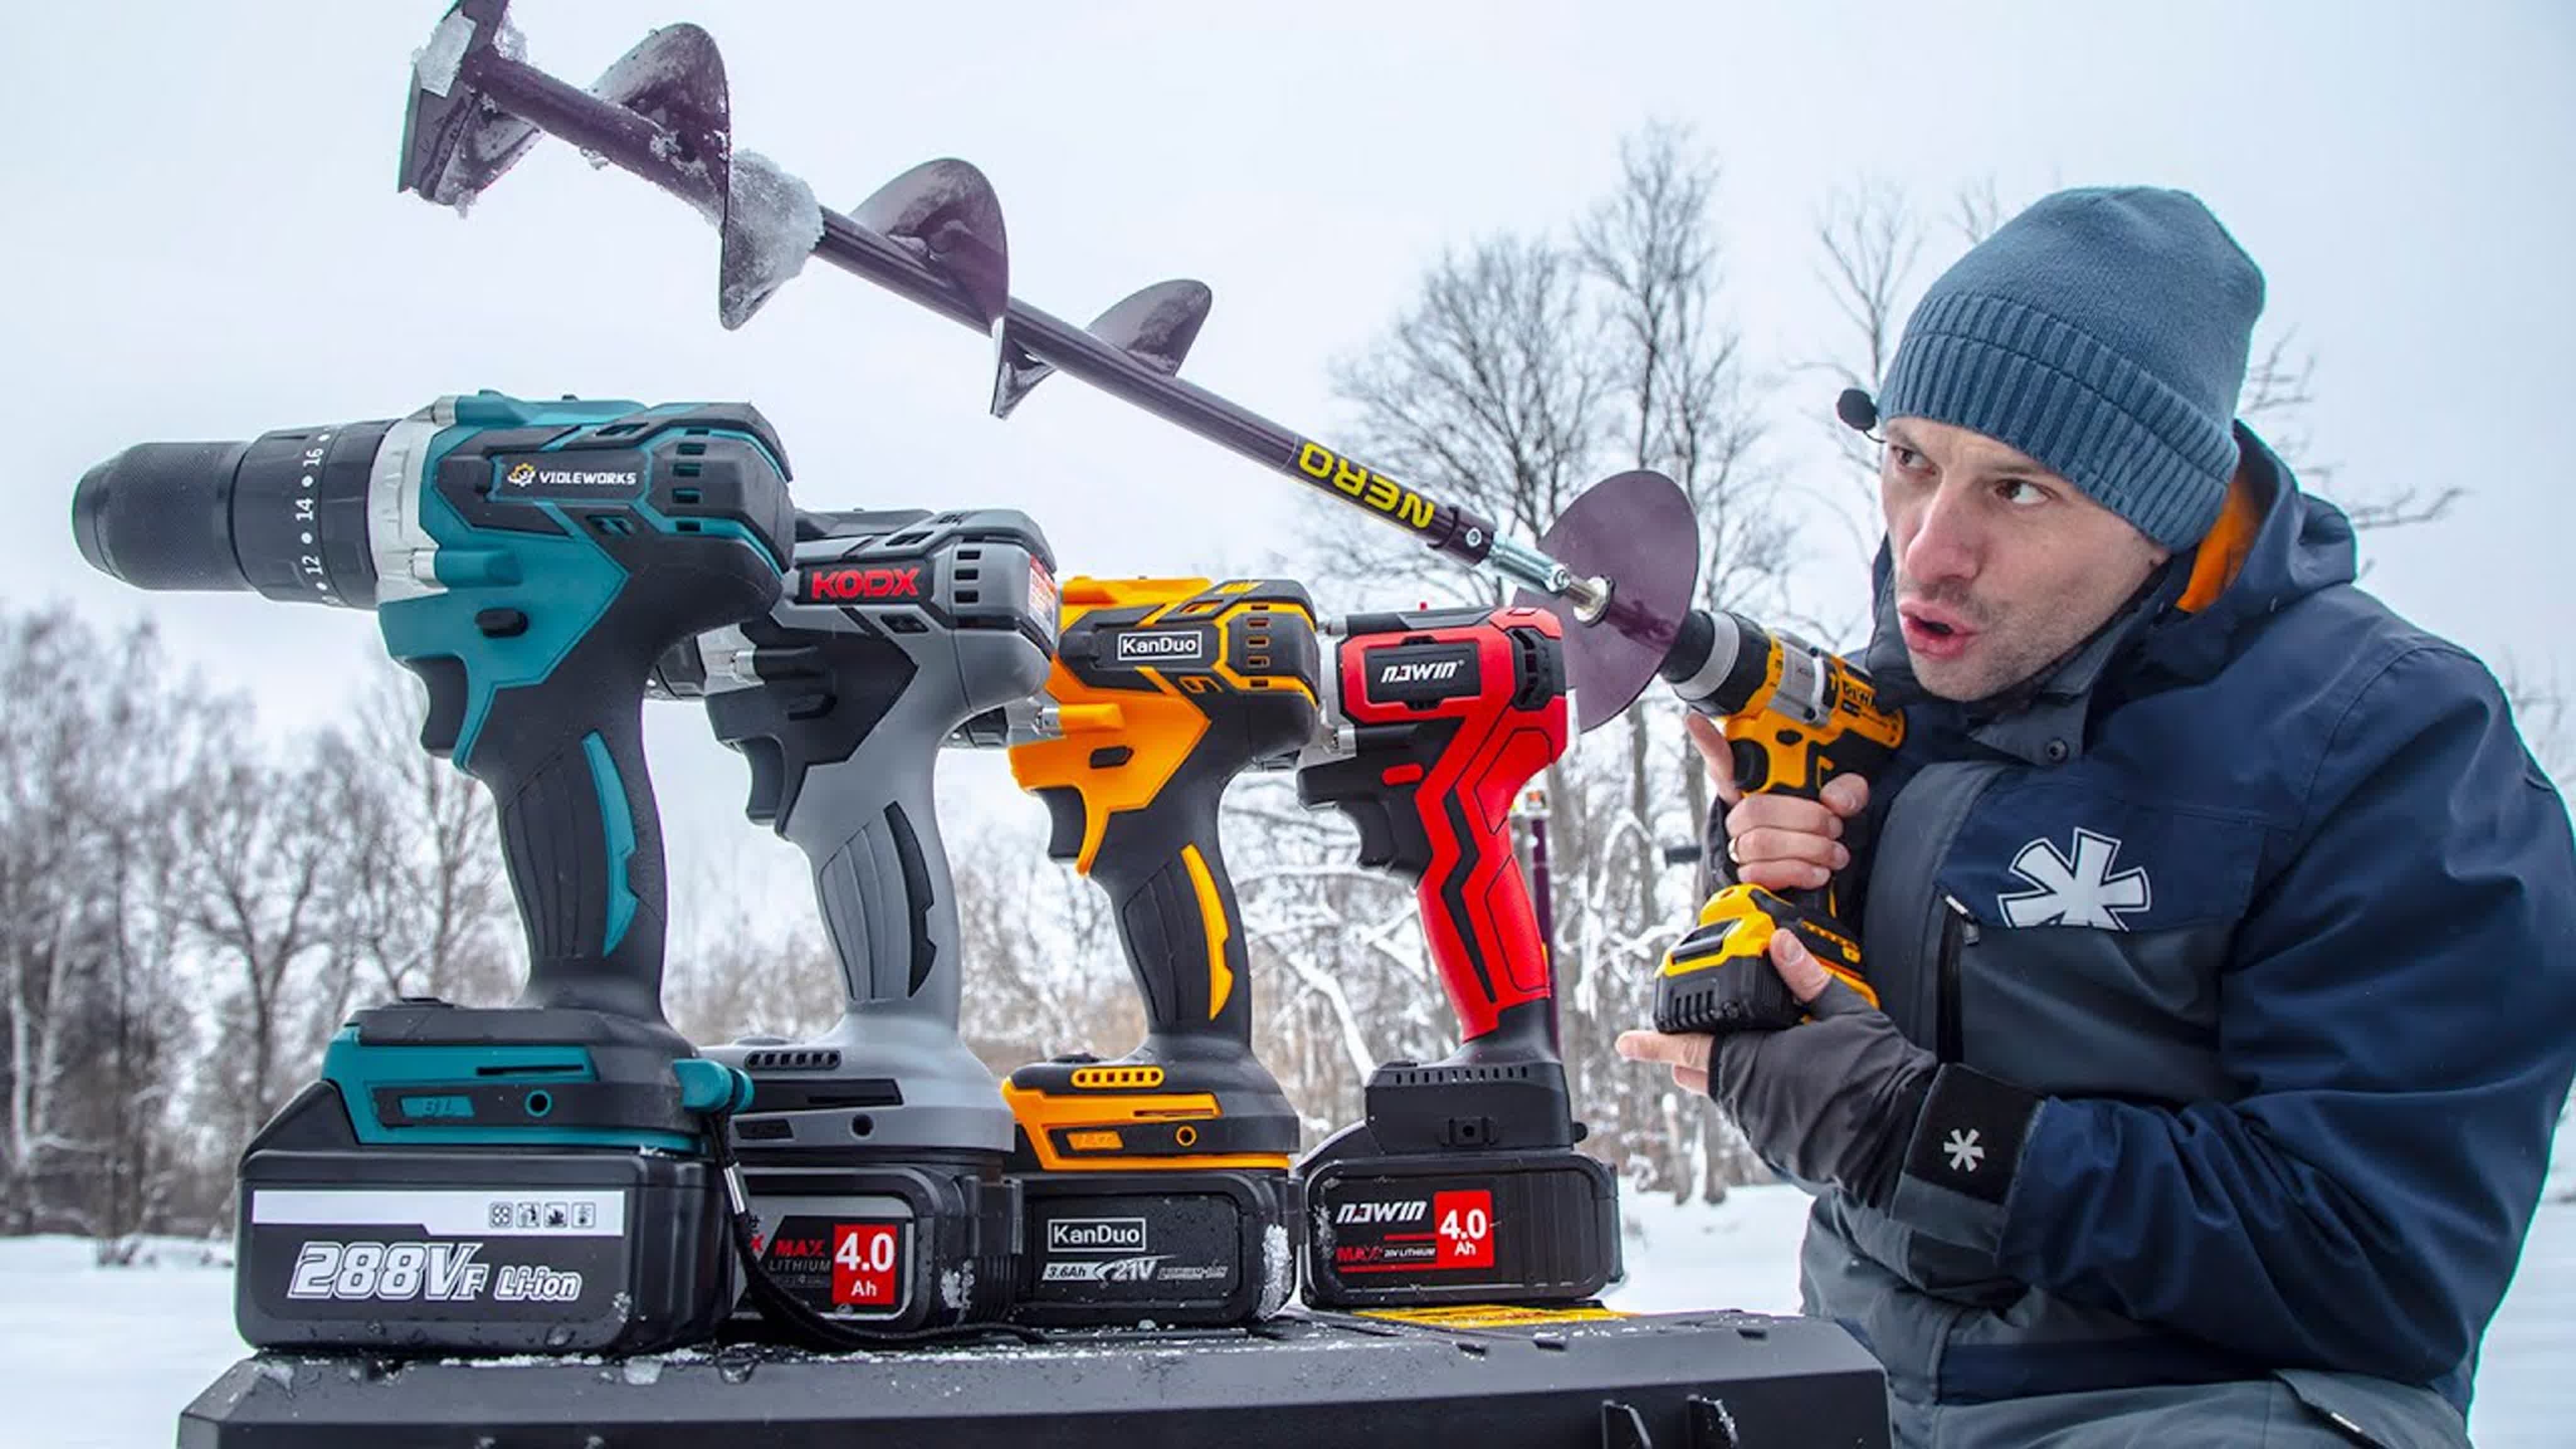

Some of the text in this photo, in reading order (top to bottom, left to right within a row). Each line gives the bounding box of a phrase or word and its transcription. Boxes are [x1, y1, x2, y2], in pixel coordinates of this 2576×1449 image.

[539, 472, 636, 485] VIOLEWORKS
[1298, 441, 1435, 529] NERO
[296, 448, 324, 575] 12 14 16
[811, 568, 921, 599] KODX
[1122, 636, 1197, 654] KanDuo
[1053, 1224, 1140, 1244] KanDuo
[1440, 1208, 1487, 1240] 4.0
[775, 1238, 825, 1257] MAX
[835, 1232, 895, 1272] 4.0
[1455, 1241, 1477, 1257] Ah
[768, 1259, 831, 1272] LITHIUM
[1046, 1266, 1086, 1278] 3.6Ah
[1111, 1258, 1157, 1280] 21V
[494, 1265, 582, 1301] Li-ion
[851, 1279, 877, 1297] Ah
